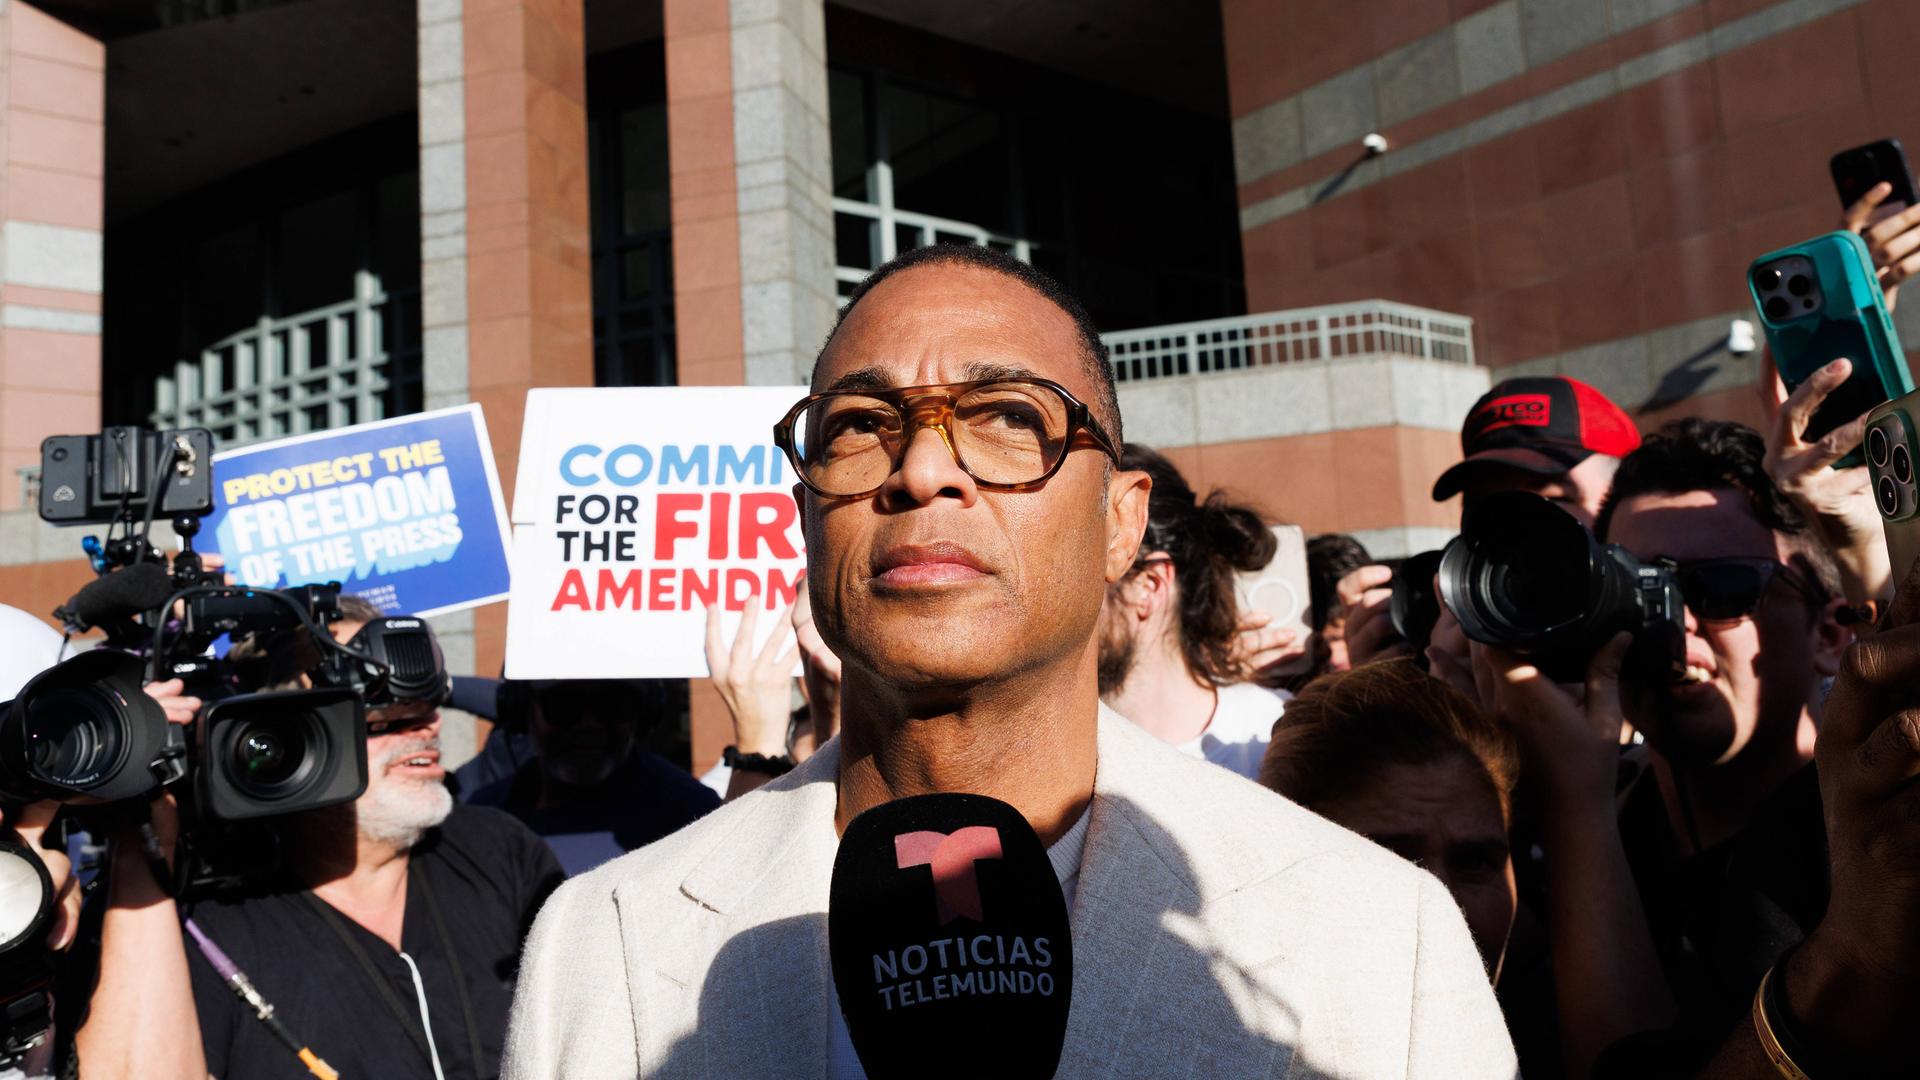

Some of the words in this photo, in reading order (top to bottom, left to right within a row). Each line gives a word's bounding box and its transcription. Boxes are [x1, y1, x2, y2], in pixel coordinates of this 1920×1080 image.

[223, 452, 373, 504] PROTECT
[379, 439, 445, 472] THE
[559, 444, 804, 487] COMMI
[228, 466, 456, 551] FREEDOM
[556, 494, 639, 525] FOR
[654, 492, 807, 560] FIR
[240, 551, 283, 587] OF
[288, 533, 356, 577] THE
[361, 512, 463, 562] PRESS
[556, 530, 636, 562] THE
[872, 935, 1053, 984] NOTICIAS
[878, 970, 1055, 1011] TELEMUNDO
